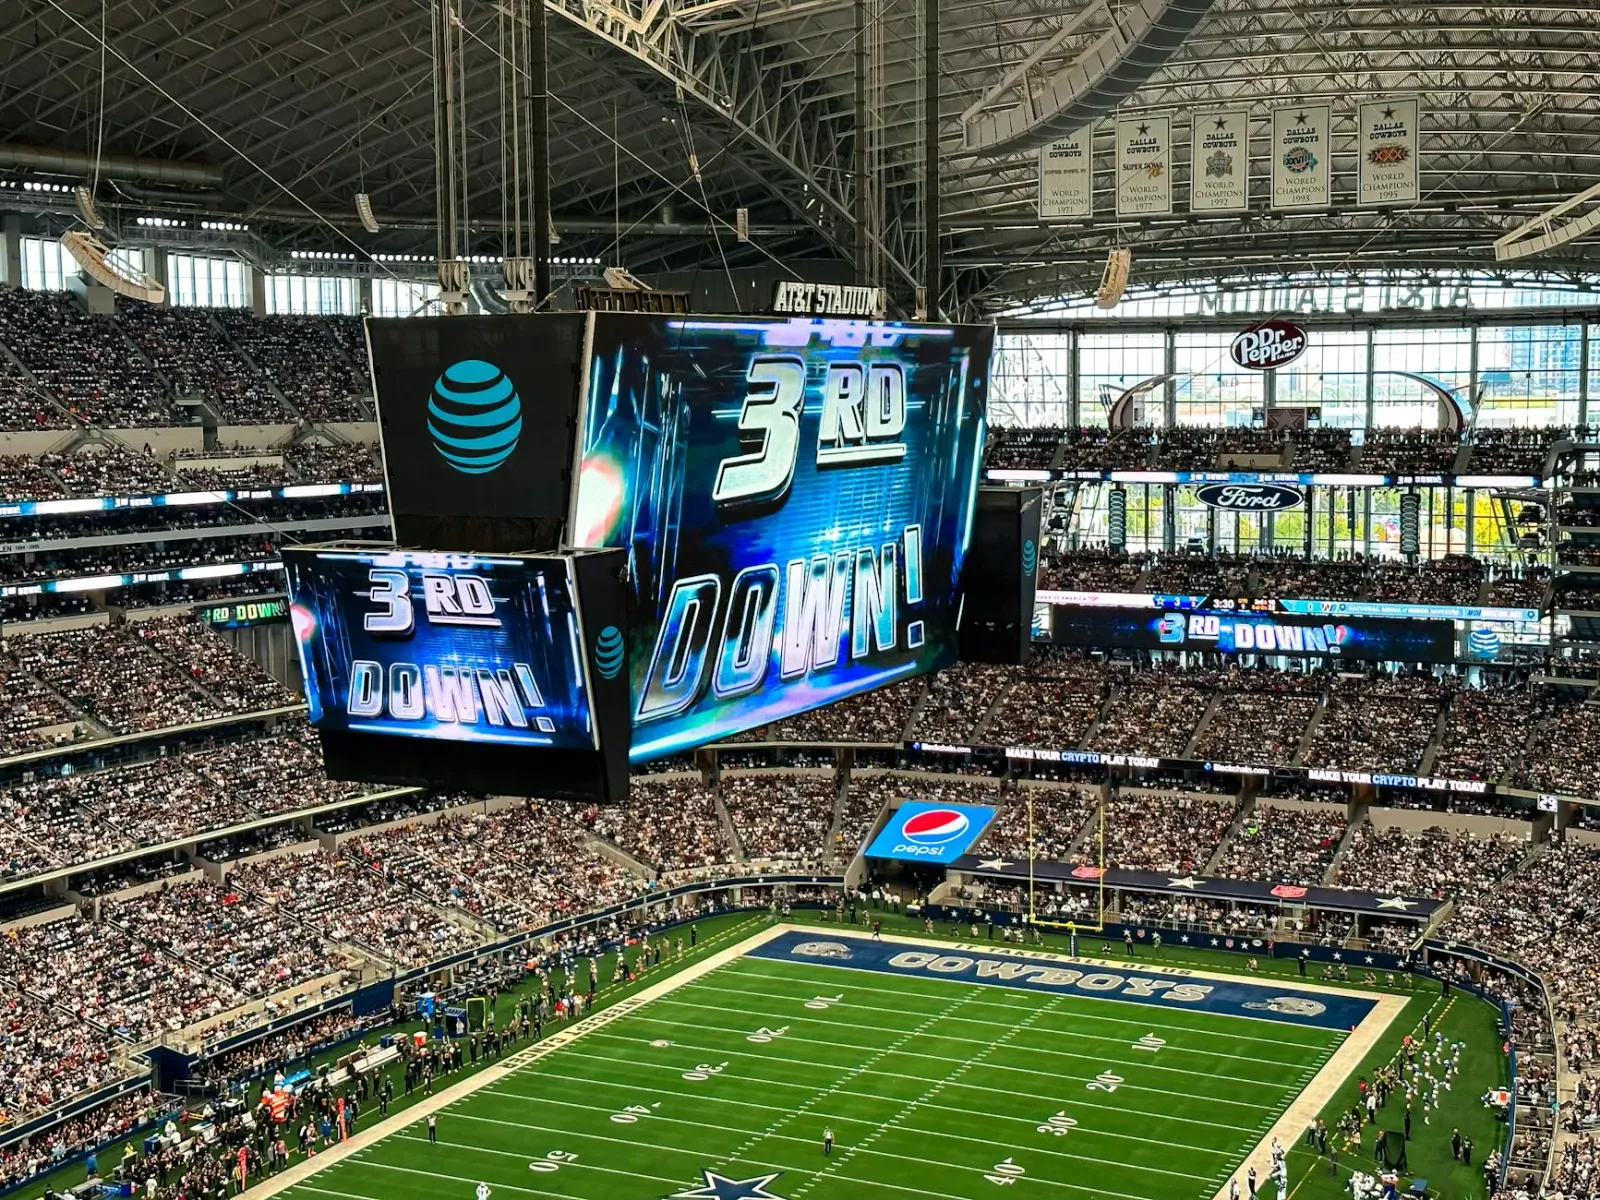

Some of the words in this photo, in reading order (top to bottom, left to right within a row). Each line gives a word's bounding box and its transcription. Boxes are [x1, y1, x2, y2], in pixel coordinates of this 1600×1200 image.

[1374, 122, 1403, 131] DALLAS
[1286, 128, 1316, 136] DALLAS
[1370, 130, 1407, 140] COWBOYS
[1206, 133, 1234, 141] DALLAS
[1283, 136, 1319, 144] COWBOYS
[1130, 138, 1157, 146] DALLAS
[1202, 141, 1237, 149] COWBOYS
[1049, 150, 1082, 158] COWBOYS
[1126, 146, 1160, 154] COWBOYS
[1122, 162, 1142, 171] SUPER
[1285, 177, 1316, 185] WORLD
[1372, 173, 1404, 181] WORLD
[1204, 181, 1234, 189] WORLD
[1292, 195, 1310, 203] 1993
[1379, 191, 1398, 200] 1995
[1135, 203, 1153, 211] 1977
[1210, 199, 1228, 207] 1992
[1058, 206, 1073, 214] 1971
[773, 281, 815, 313] AT&T
[816, 284, 879, 315] STADIUM
[1258, 328, 1286, 348] Dr
[1216, 486, 1282, 508] Ford
[1174, 598, 1181, 606] 3
[1212, 598, 1235, 609] 3:30
[634, 523, 925, 726] DOWN!
[1234, 624, 1341, 654] DOWN!
[347, 660, 556, 733] DOWN!
[920, 742, 972, 754] Blockchain.com
[1006, 748, 1034, 759] MAKE
[1034, 750, 1060, 761] YOUR
[1062, 752, 1100, 764] CRYPTO
[1100, 754, 1126, 766] PLAY
[1127, 756, 1160, 768] TODAY
[1213, 763, 1270, 774] Blockchain.com
[1308, 770, 1340, 782] MAKE
[1341, 772, 1372, 784] YOUR
[1372, 774, 1416, 787] CRYPTO
[1418, 777, 1447, 790] PLAY
[1449, 779, 1486, 792] TODAY
[892, 844, 945, 856] pepsi
[954, 943, 971, 952] IT
[988, 948, 1059, 961] TAKES
[1066, 957, 1109, 967] ALL
[1122, 963, 1151, 971] OF
[1162, 968, 1193, 976] US
[888, 952, 1215, 1002] COWBOYS
[565, 998, 646, 1036] INTERCEPT
[502, 1038, 566, 1069] CANCER
